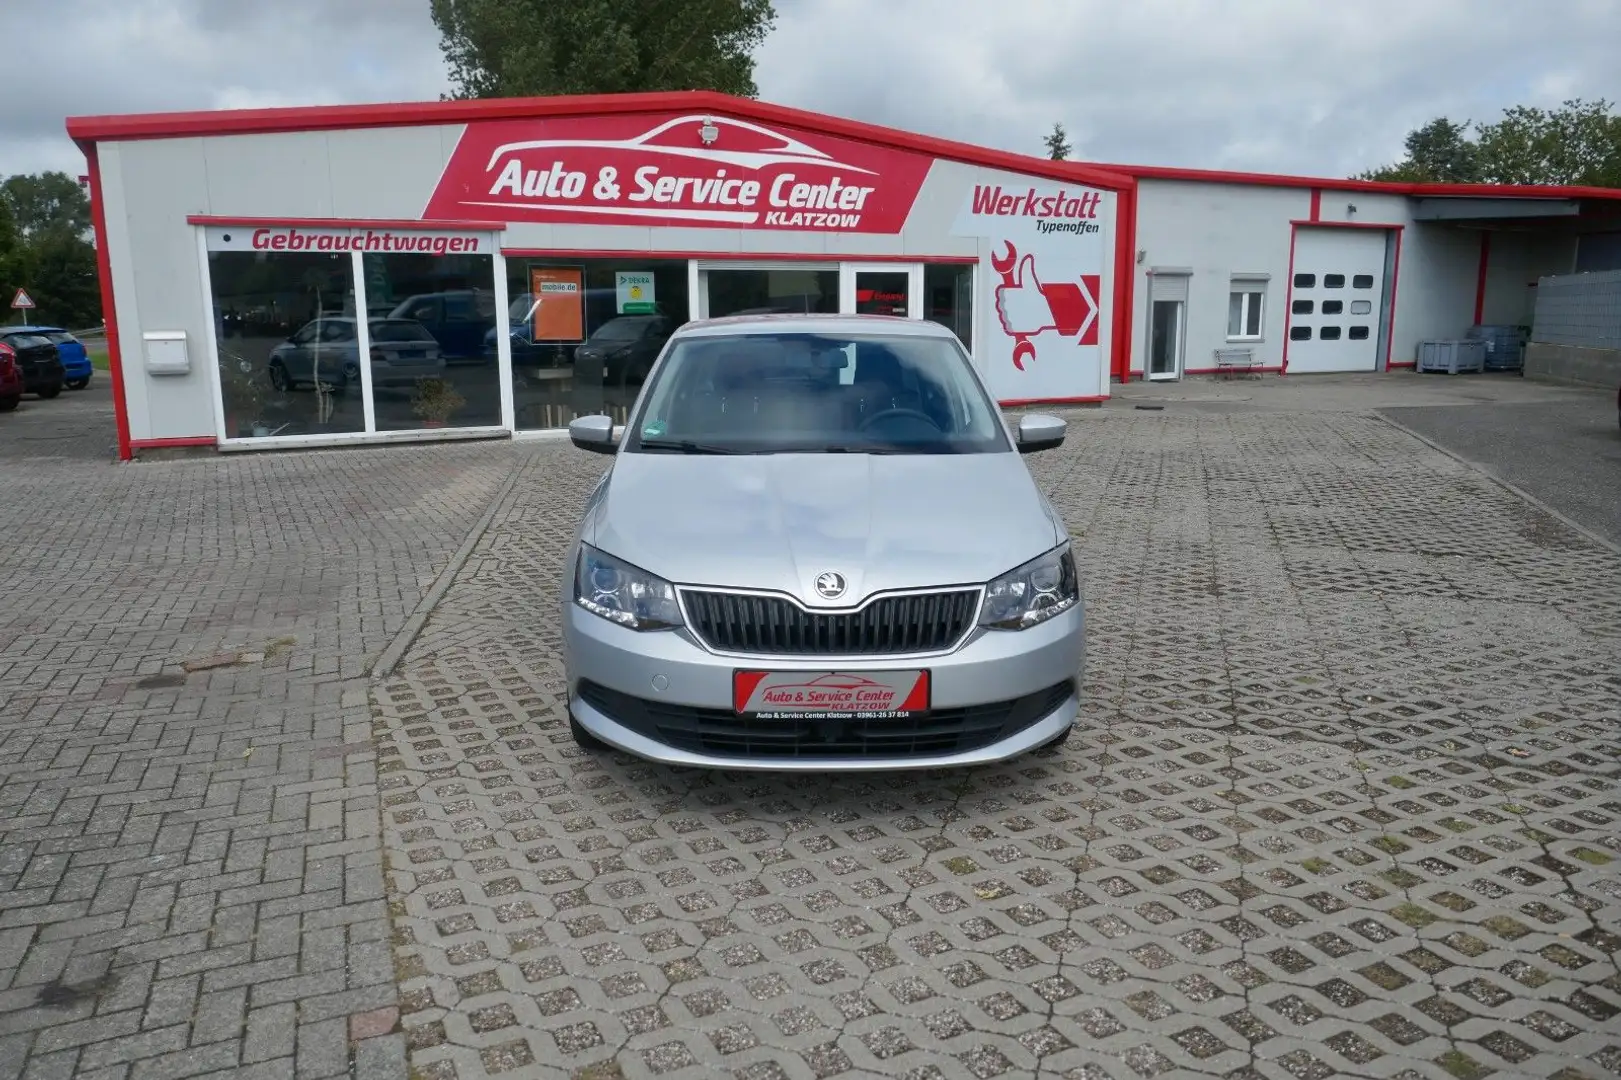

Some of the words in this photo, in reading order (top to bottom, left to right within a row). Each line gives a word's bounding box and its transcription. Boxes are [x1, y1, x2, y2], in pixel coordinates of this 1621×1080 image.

[489, 159, 585, 200] Auto
[592, 166, 622, 200] &
[628, 168, 761, 207] Service
[768, 173, 875, 211] Center
[971, 185, 1102, 219] Werkstatt
[764, 211, 862, 228] KLATZOW
[1036, 219, 1099, 235] Typenoffen
[252, 228, 479, 257] Gebrauchtwagen
[541, 282, 576, 292] mobile.de
[628, 276, 650, 284] DEKRA
[763, 691, 793, 702] Auto
[795, 692, 804, 702] &
[807, 690, 852, 702] Service
[856, 690, 896, 701] Center
[831, 702, 890, 710] KLATZOW
